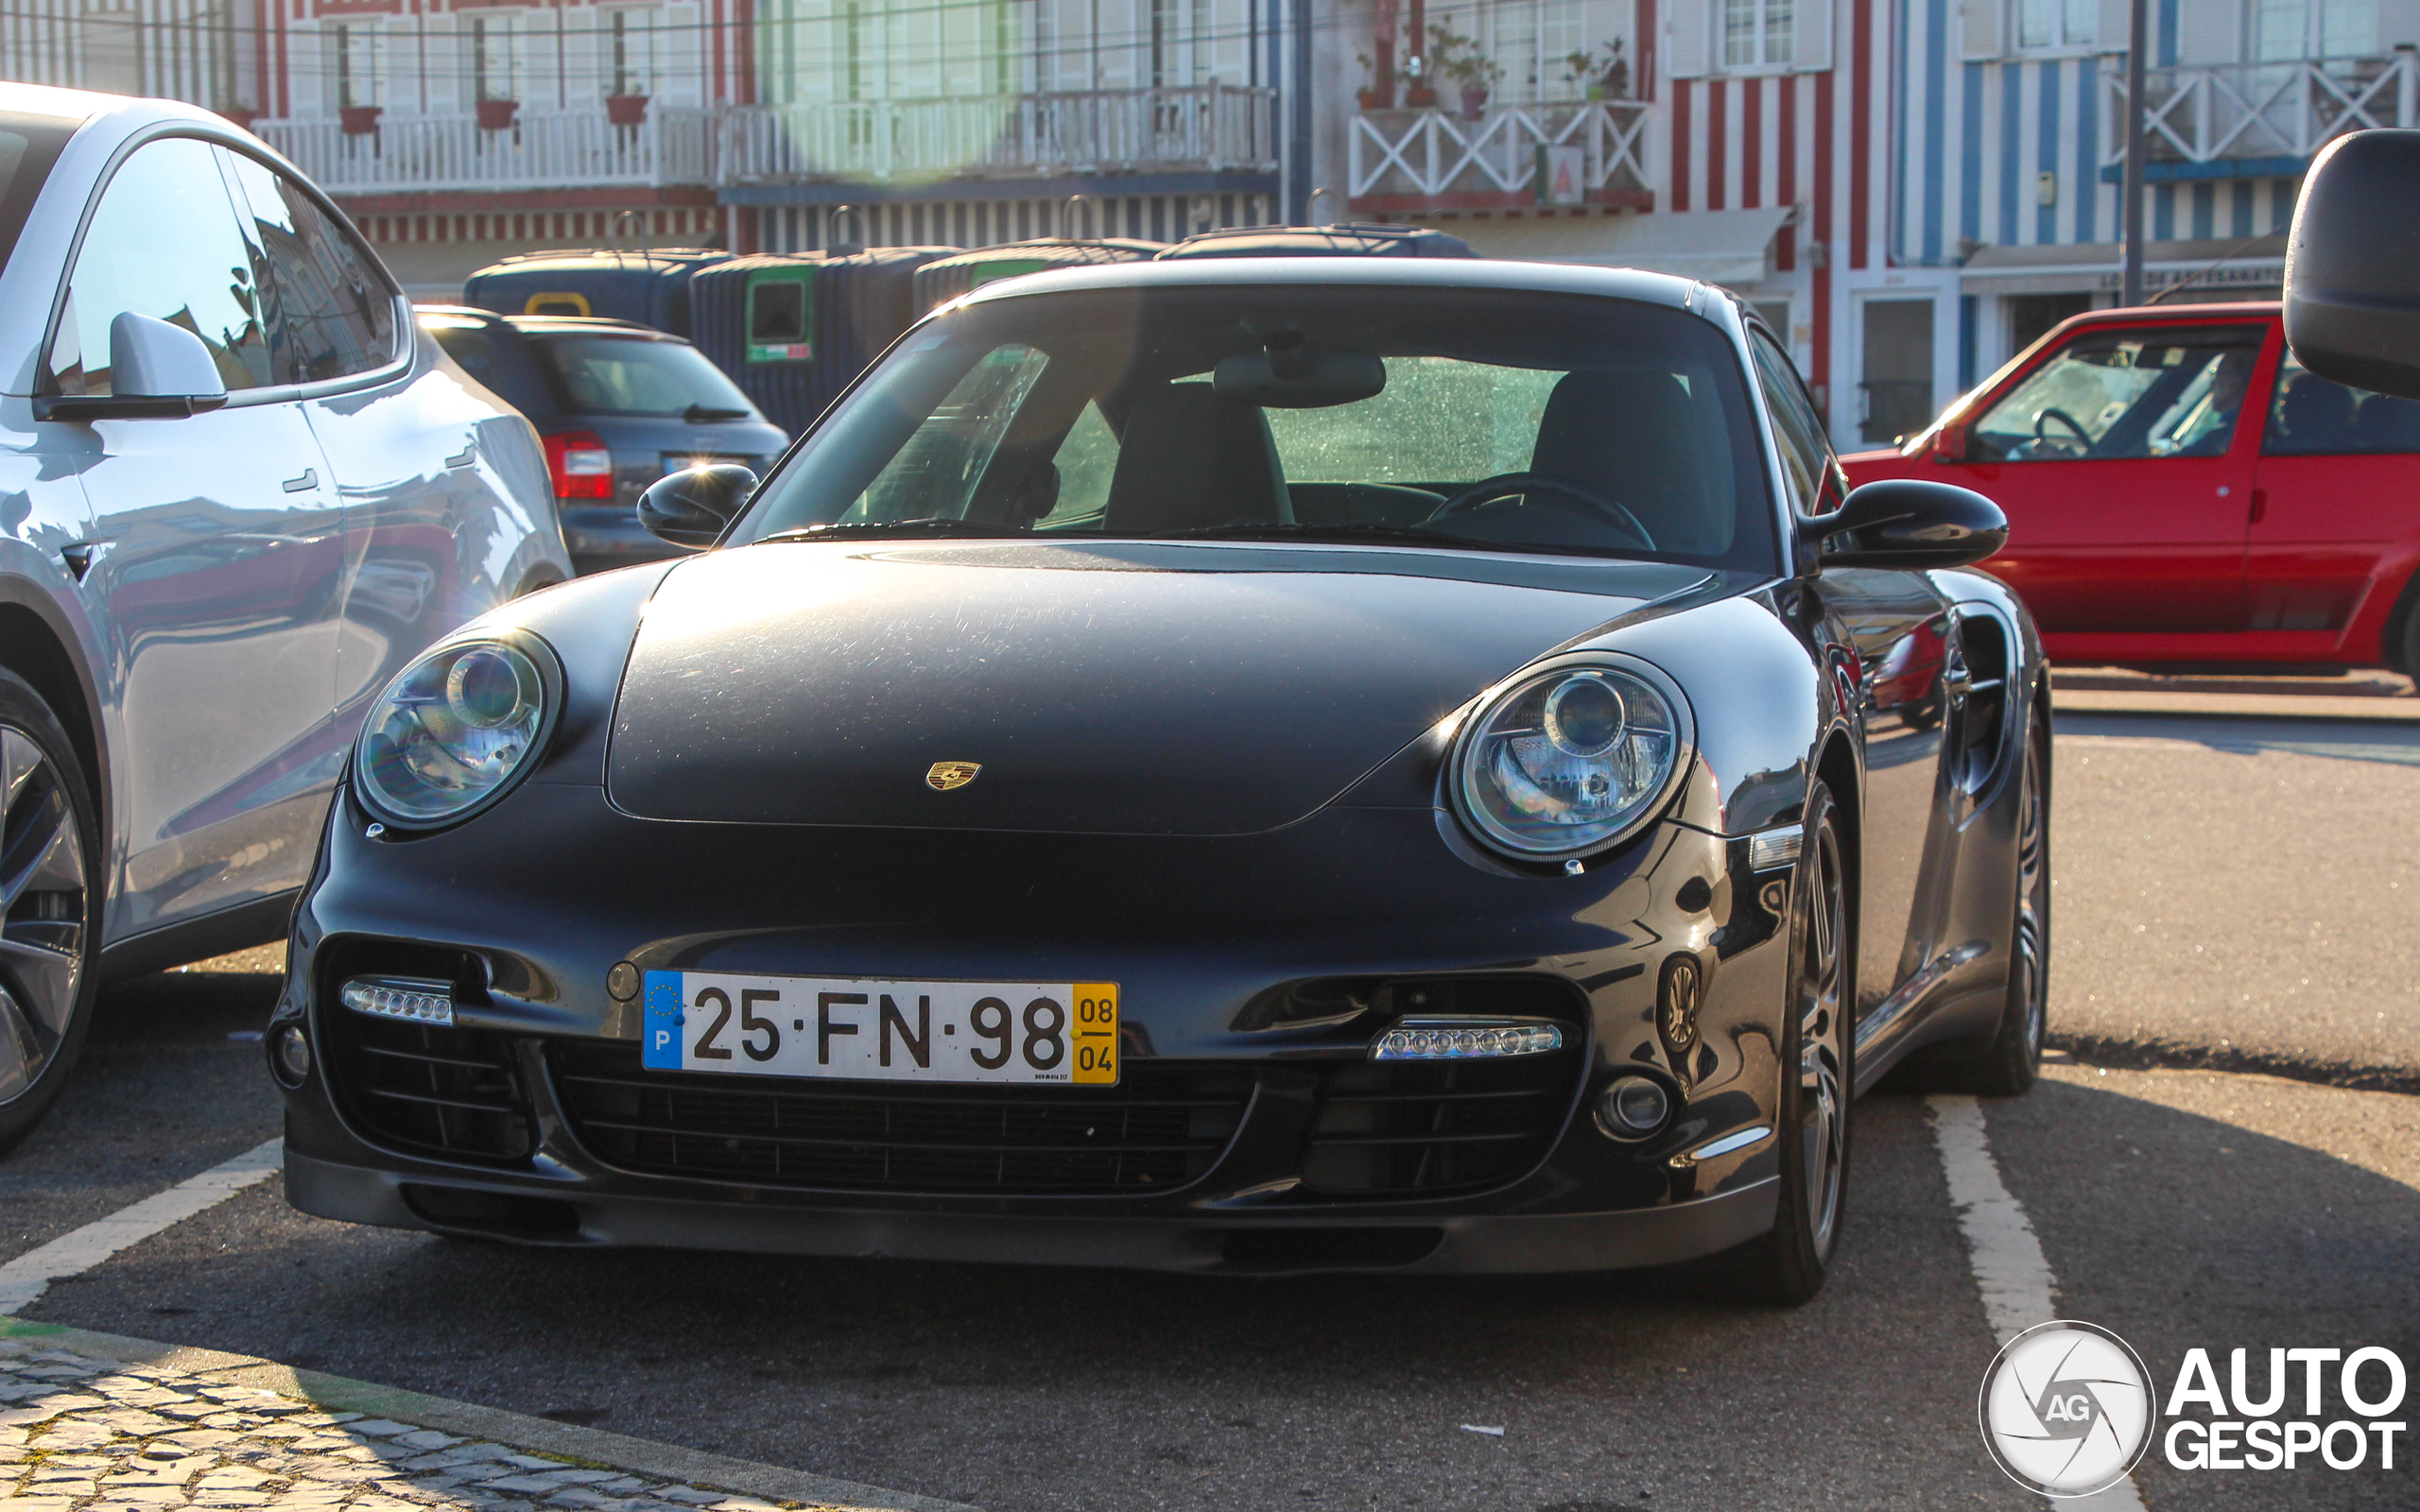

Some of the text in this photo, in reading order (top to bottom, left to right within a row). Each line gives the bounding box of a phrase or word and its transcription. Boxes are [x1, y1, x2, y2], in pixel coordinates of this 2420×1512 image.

[2147, 271, 2165, 285] DE
[1080, 998, 1113, 1023] 08
[655, 1030, 670, 1051] P
[1080, 1046, 1112, 1072] 04
